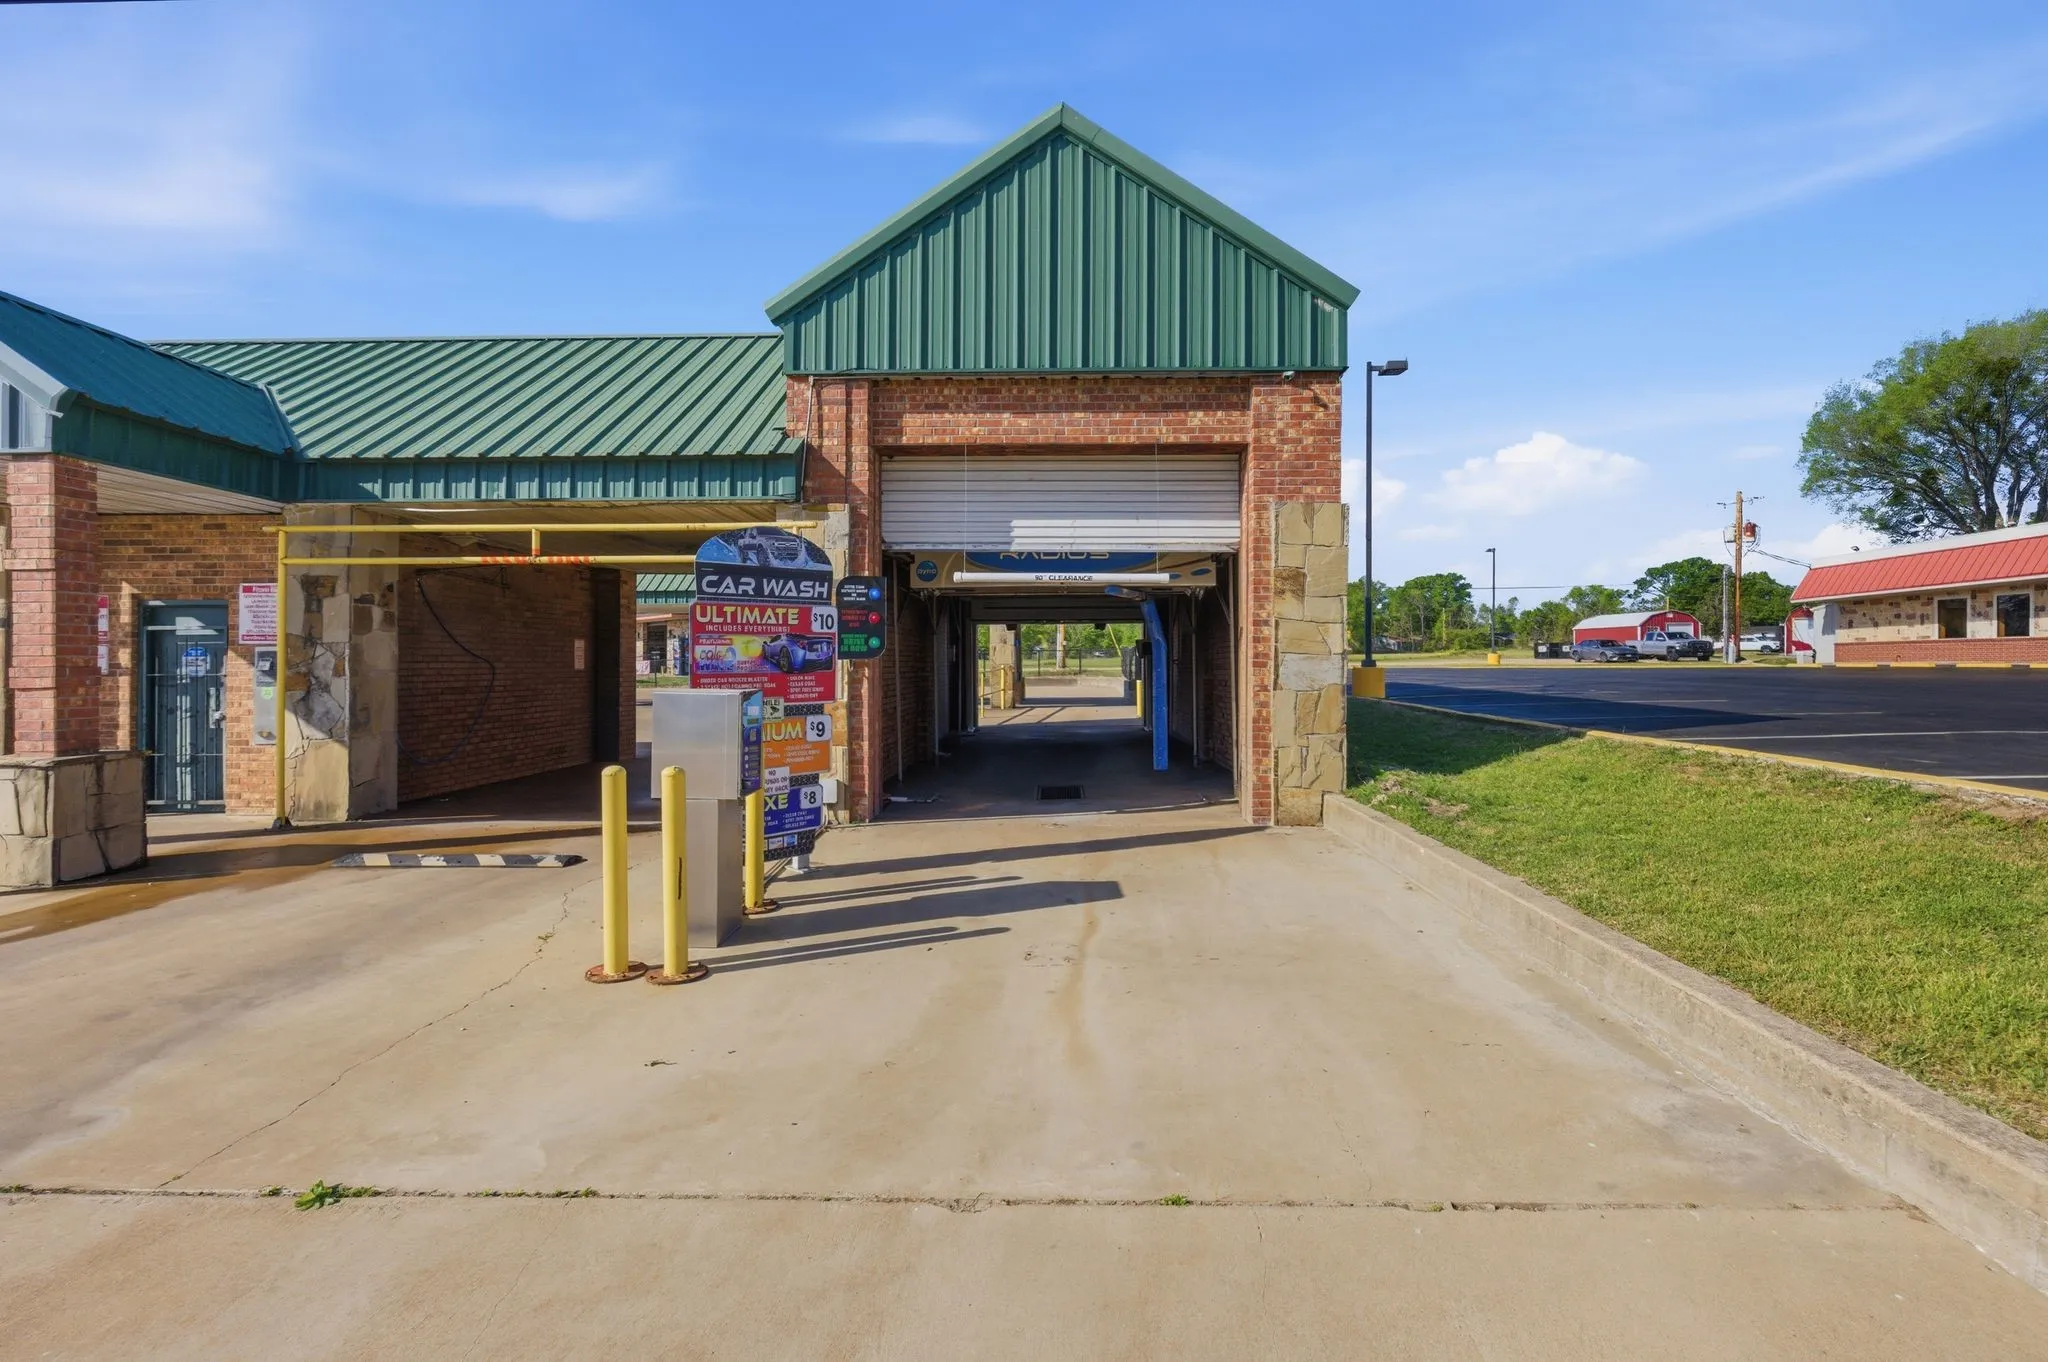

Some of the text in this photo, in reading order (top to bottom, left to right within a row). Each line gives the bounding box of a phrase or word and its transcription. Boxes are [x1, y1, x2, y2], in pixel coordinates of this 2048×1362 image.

[701, 575, 754, 596] CAR
[763, 579, 828, 598] WASH
[696, 604, 800, 625] ULTIMATE
[813, 613, 834, 630] $10
[762, 721, 802, 741] IUM
[810, 721, 825, 738] $9
[804, 791, 817, 804] $8
